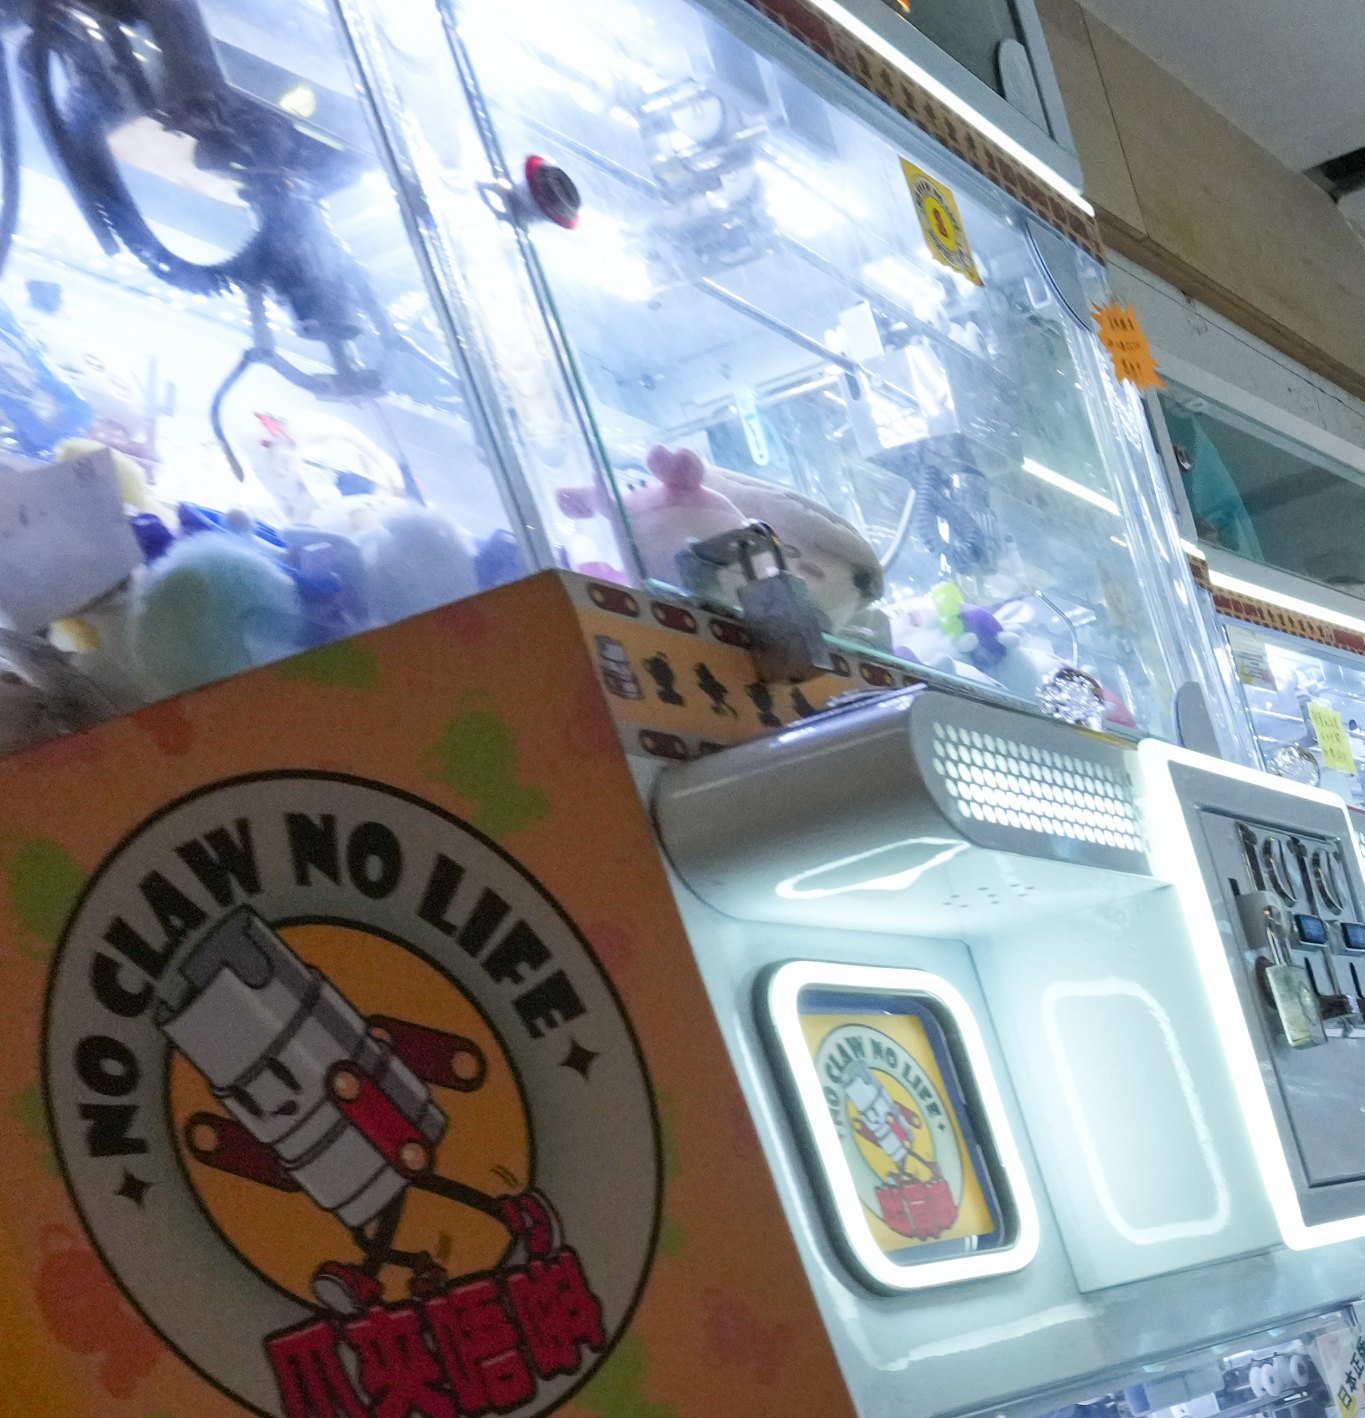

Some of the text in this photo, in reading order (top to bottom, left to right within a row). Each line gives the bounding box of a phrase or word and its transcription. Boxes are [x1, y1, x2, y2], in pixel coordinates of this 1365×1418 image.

[74, 811, 590, 1158] NO CLAW NO LIFE
[823, 1035, 867, 1084] CLAW
[869, 1037, 898, 1069] NO
[902, 1062, 943, 1117] LIFE
